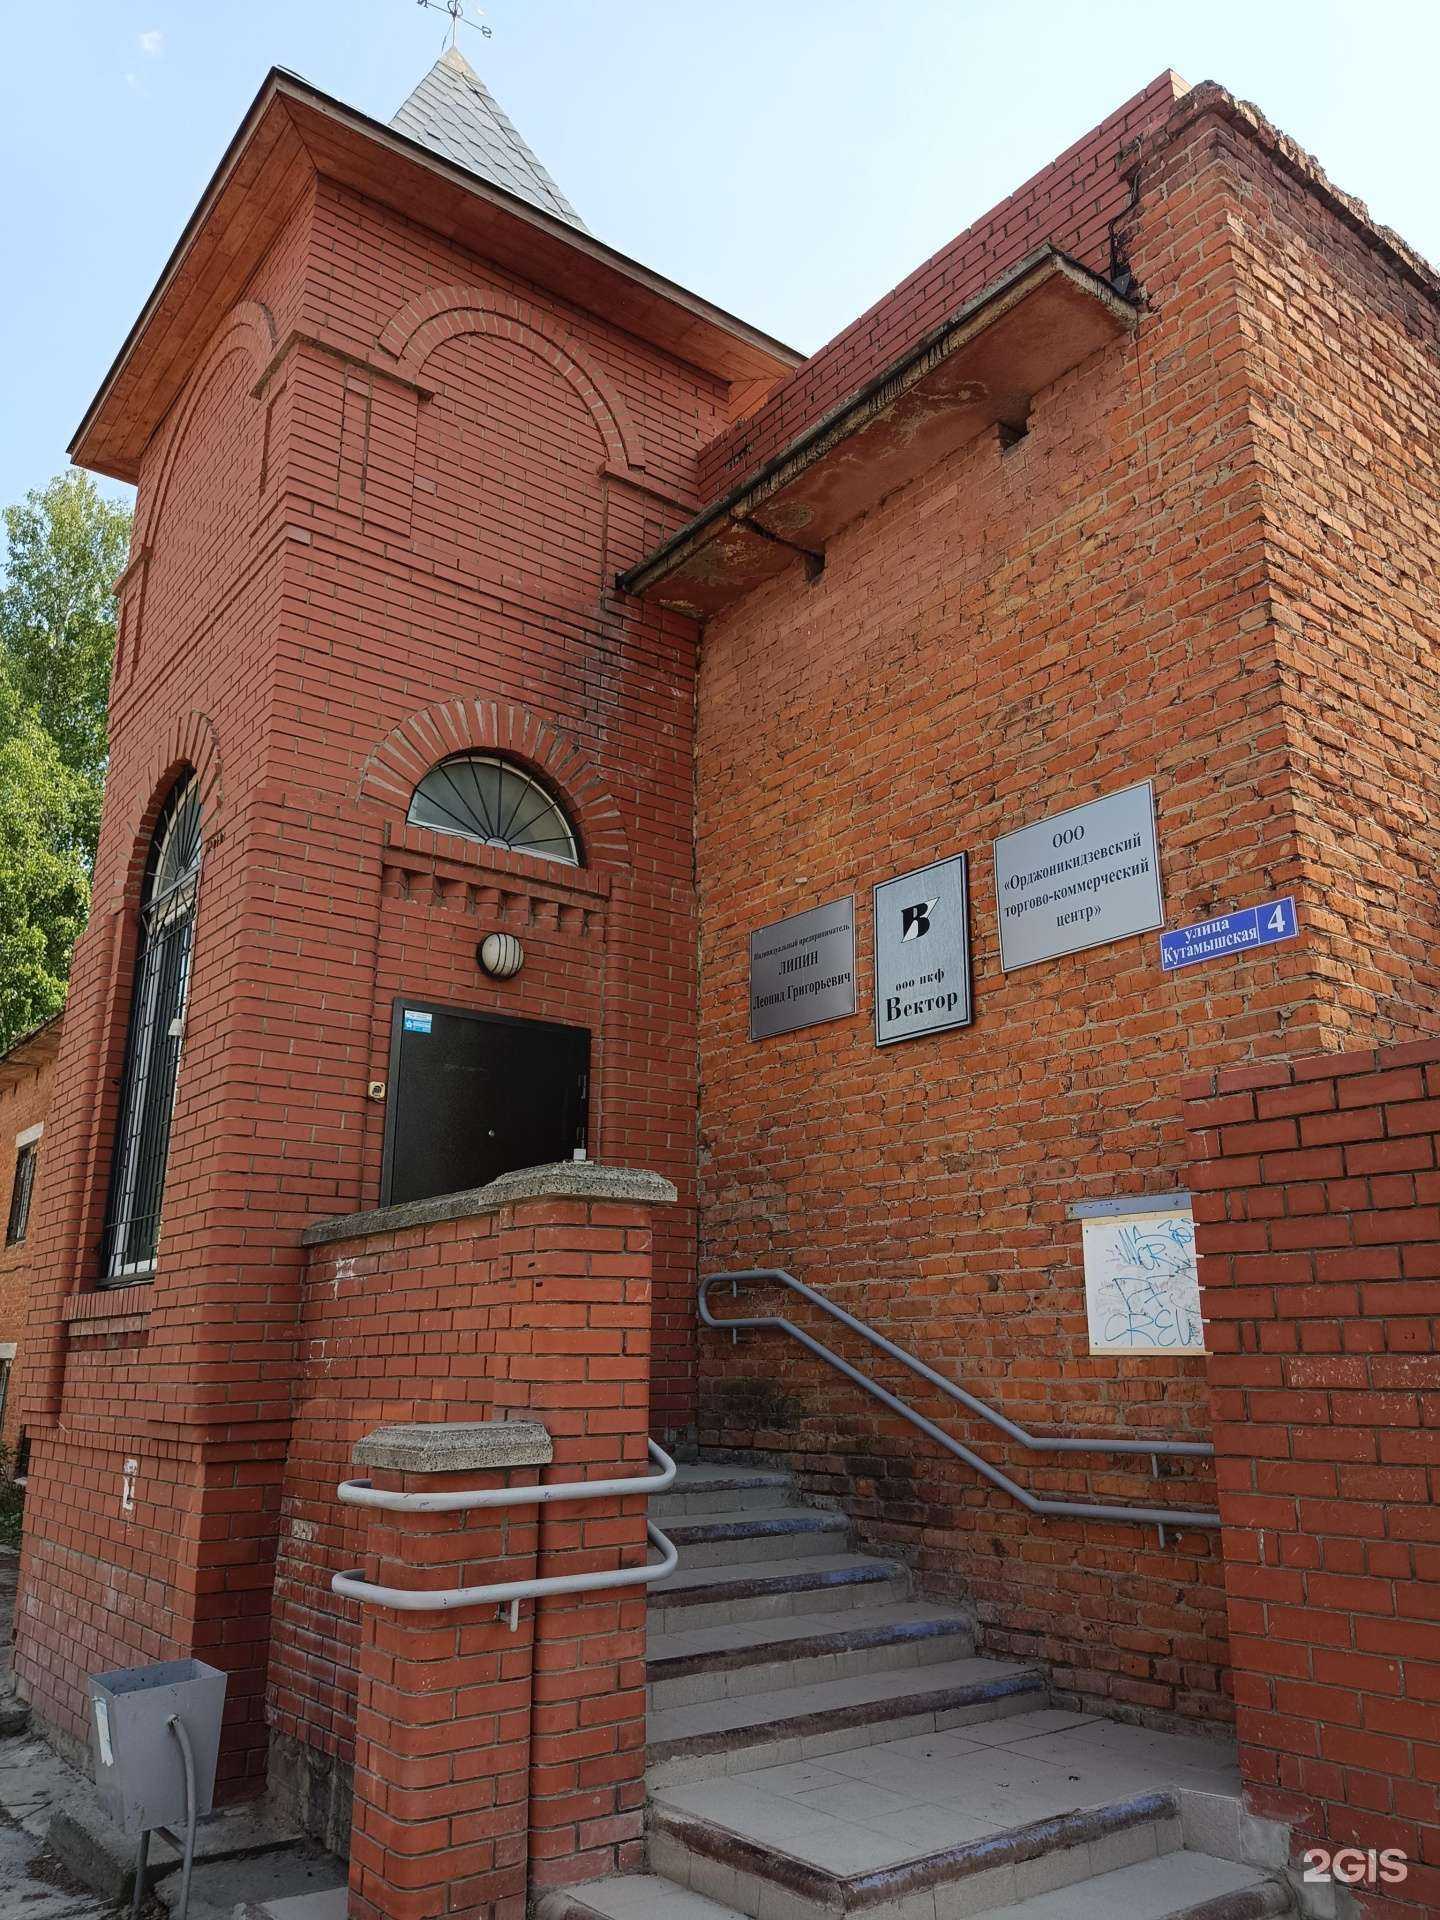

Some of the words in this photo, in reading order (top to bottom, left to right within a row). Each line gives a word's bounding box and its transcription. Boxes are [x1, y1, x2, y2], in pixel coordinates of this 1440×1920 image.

[1004, 832, 1142, 892] «Орджоникидзевский
[1004, 857, 1150, 918] торгово-коммерческий
[1056, 904, 1102, 928] центр»
[1184, 919, 1230, 944] улица
[1267, 904, 1286, 933] 4
[1162, 927, 1258, 965] Кутамышская
[753, 993, 786, 1010] Леонид
[787, 972, 851, 1001] Григорьевич
[886, 991, 959, 1022] Вектор
